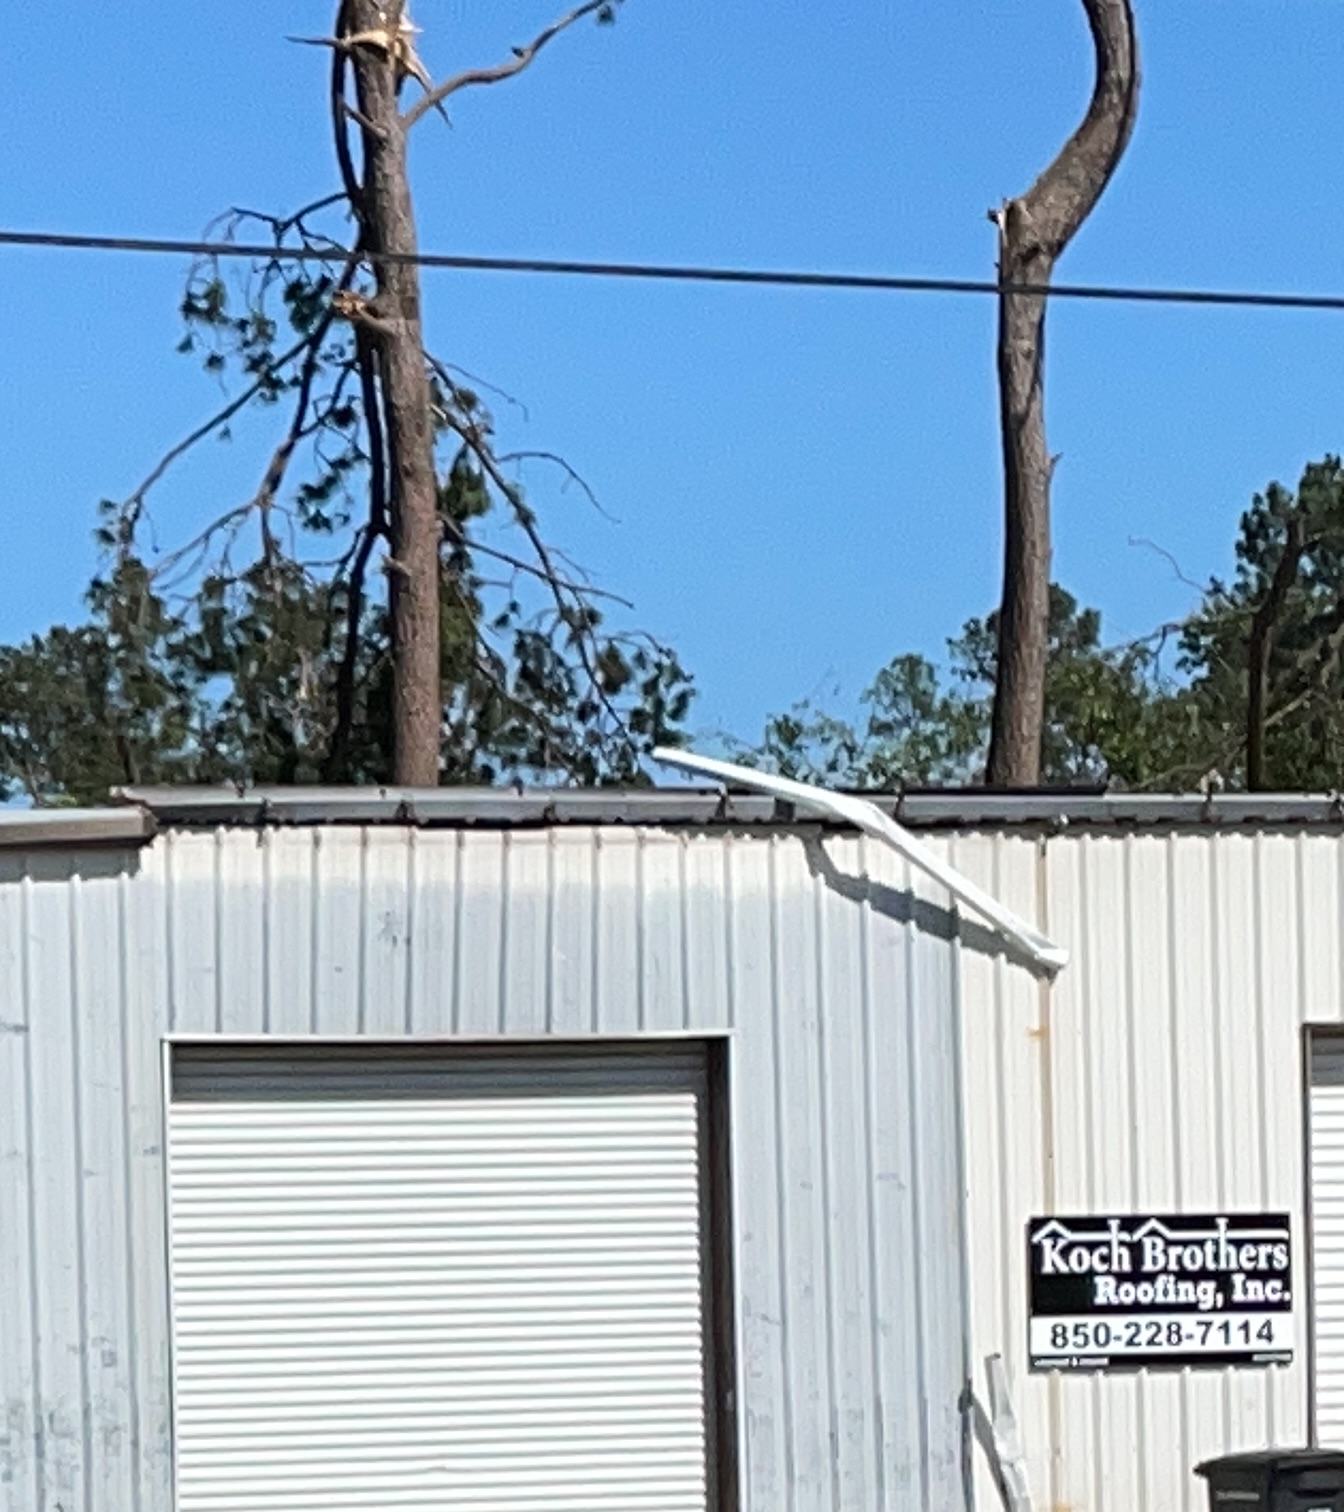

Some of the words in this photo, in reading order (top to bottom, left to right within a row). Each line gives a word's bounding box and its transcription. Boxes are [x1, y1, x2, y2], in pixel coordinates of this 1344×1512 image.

[1040, 1219, 1132, 1274] Koch
[1141, 1218, 1289, 1271] Brothers
[1093, 1275, 1224, 1310] Roofing,
[1231, 1273, 1291, 1302] Inc.
[1050, 1319, 1274, 1349] 850-228-7114
